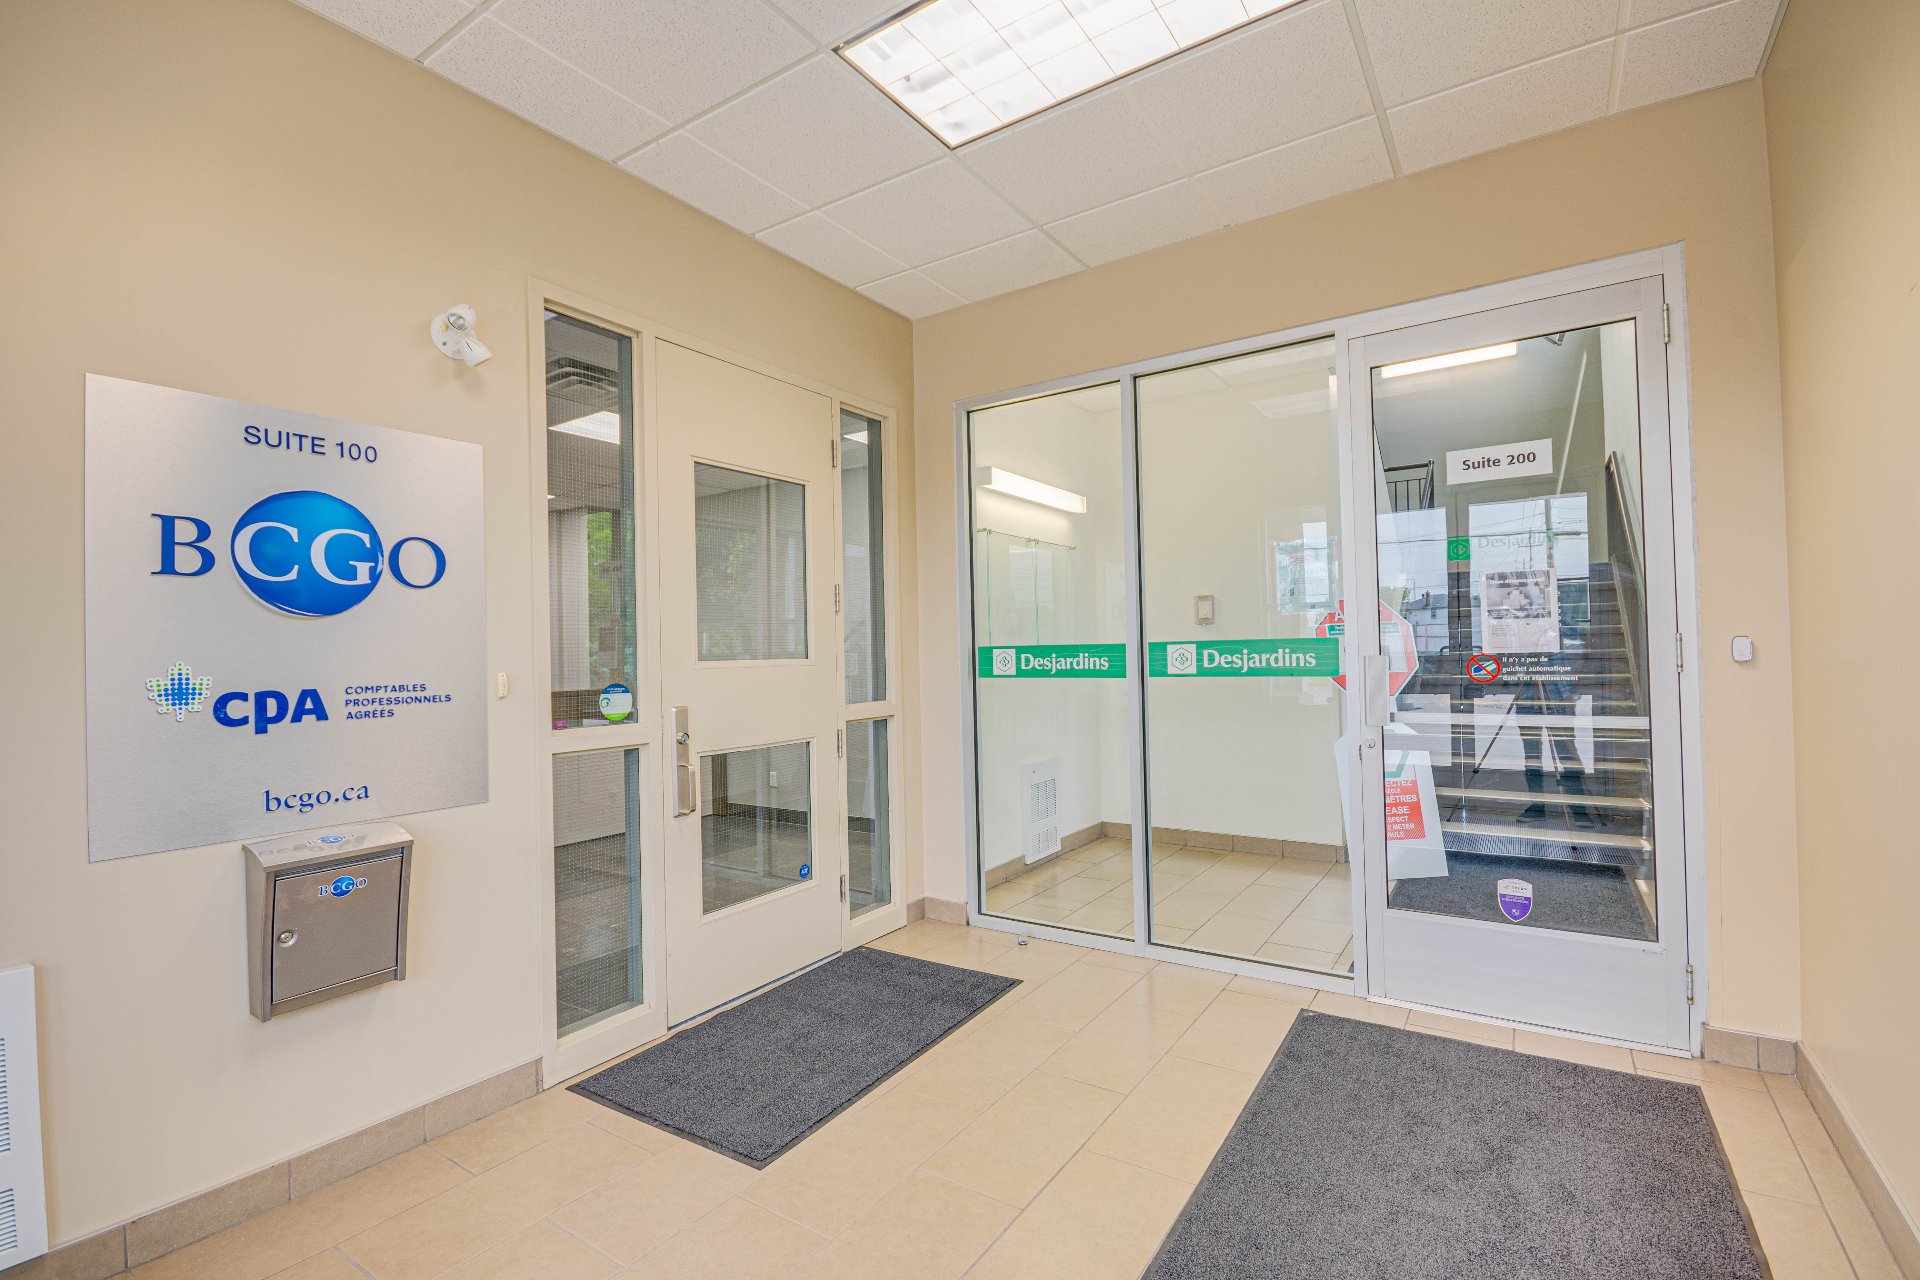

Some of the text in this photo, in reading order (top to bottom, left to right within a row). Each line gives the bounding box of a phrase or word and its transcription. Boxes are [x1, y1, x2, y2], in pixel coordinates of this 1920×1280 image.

[243, 425, 378, 463] SUITE 100
[1462, 451, 1537, 471] Suite 200
[150, 512, 447, 589] BCGO
[1020, 652, 1109, 675] Desjardins
[1203, 648, 1317, 673] Desjardins
[1502, 664, 1572, 673] guichet automatique
[345, 683, 427, 695] COMPTABLES
[345, 694, 452, 707] PROFESSIONNELS
[346, 707, 395, 720] AGRÉÉS
[264, 785, 371, 814] bcgo.ca
[1386, 805, 1410, 815] EASE
[318, 877, 367, 896] BCGO
